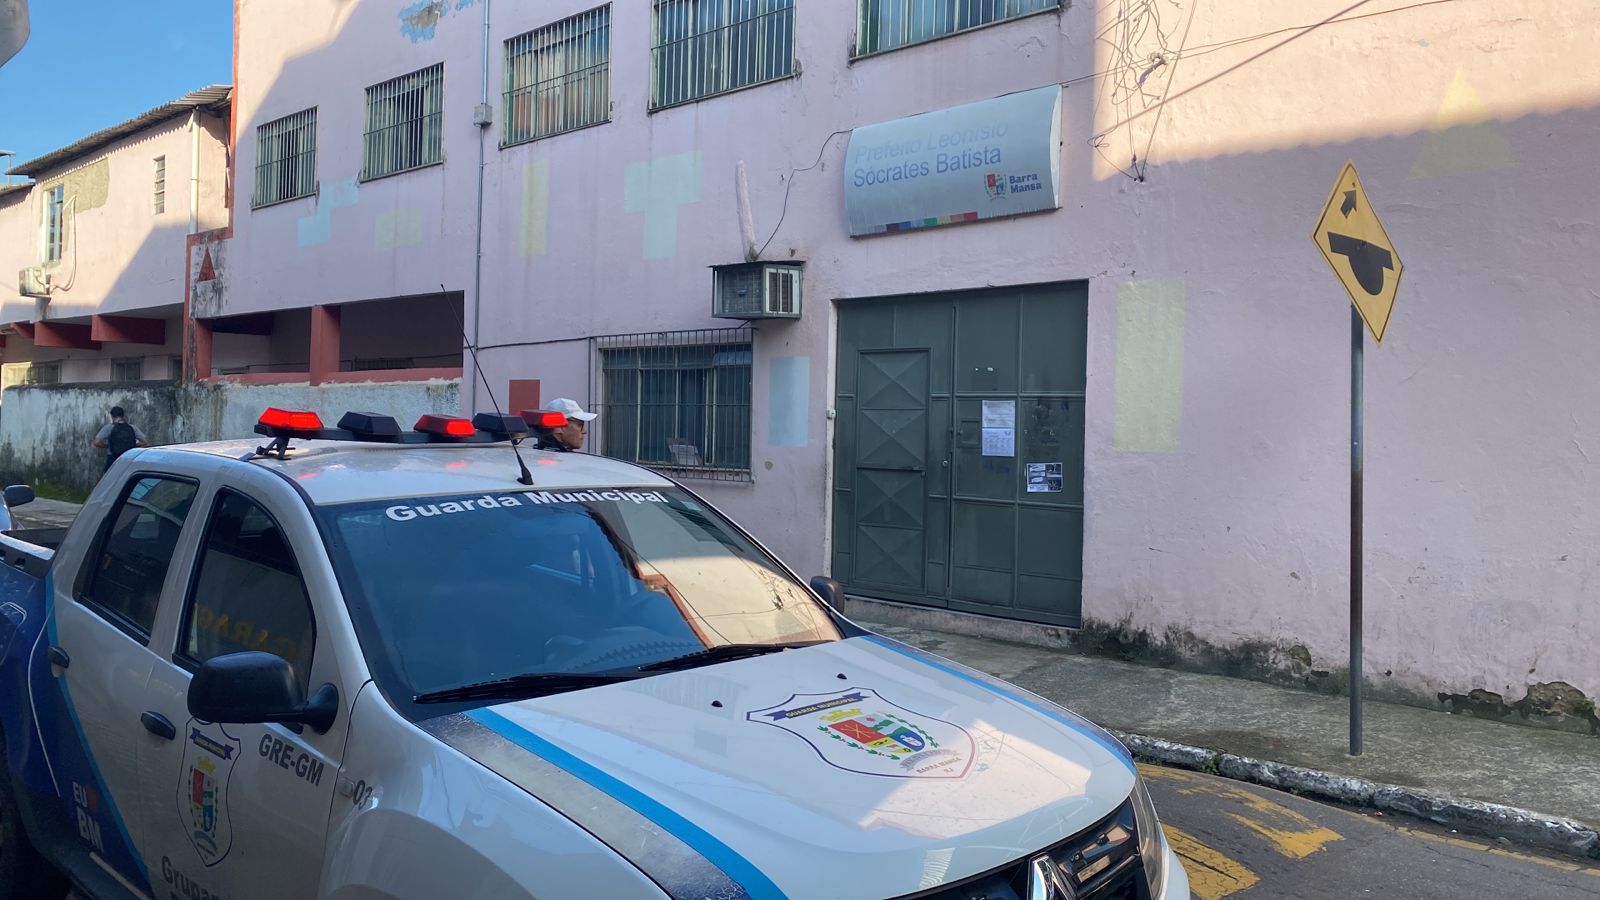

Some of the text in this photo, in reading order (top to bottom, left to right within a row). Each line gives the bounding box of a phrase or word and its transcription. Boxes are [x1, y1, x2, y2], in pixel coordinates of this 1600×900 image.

[853, 146, 1001, 187] Sócrates Batista
[1009, 173, 1038, 184] Barra
[1010, 182, 1042, 193] Mansa
[385, 489, 669, 521] Guarda Municipal
[259, 733, 324, 787] GRE-GM
[72, 781, 88, 807] EU
